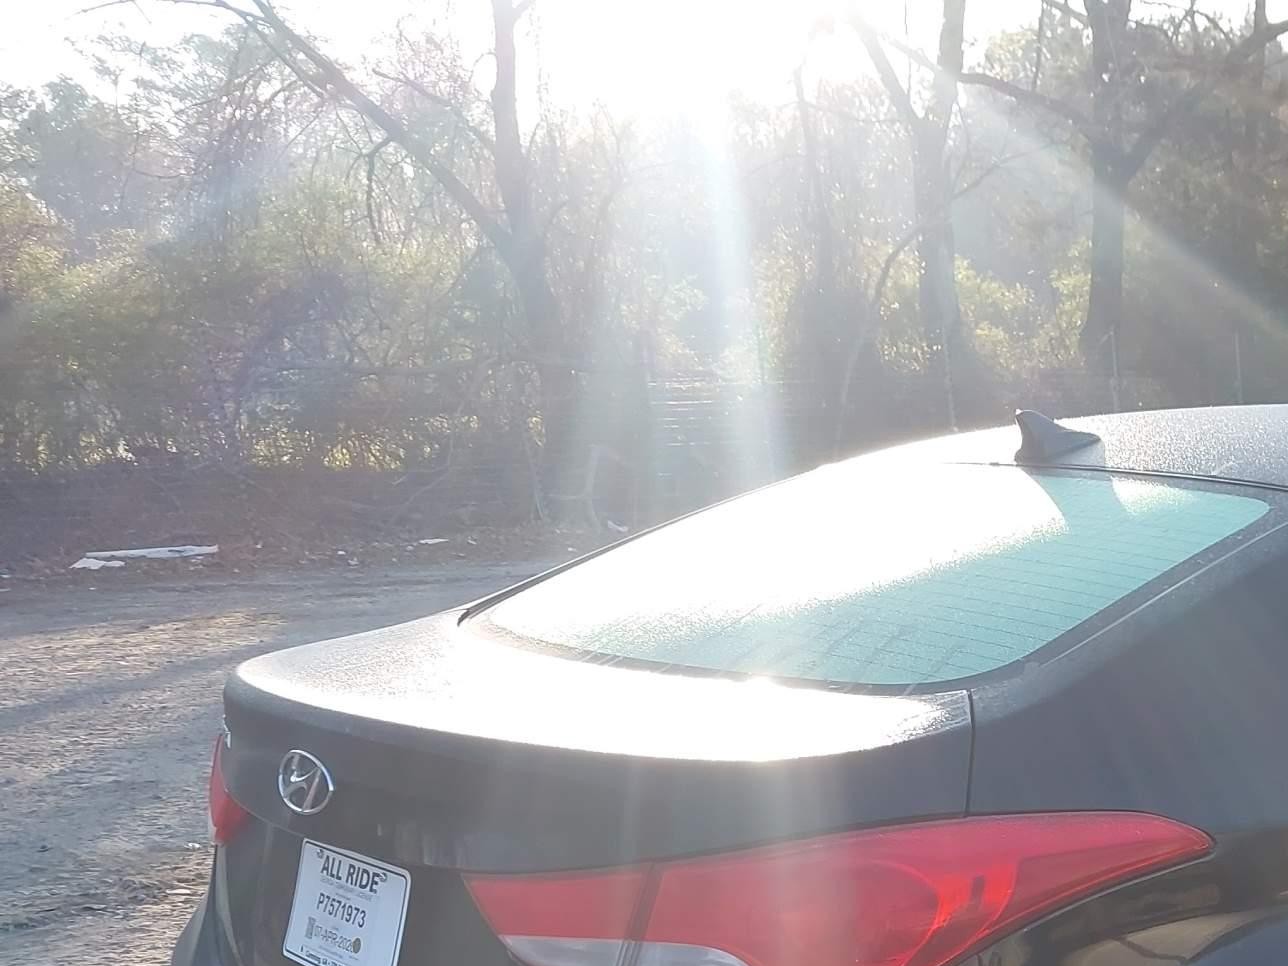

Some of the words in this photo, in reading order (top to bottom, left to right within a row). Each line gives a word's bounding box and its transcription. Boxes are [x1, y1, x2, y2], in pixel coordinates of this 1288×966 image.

[320, 855, 342, 880] ALL
[345, 863, 380, 893] RIDE
[316, 892, 366, 928] P7571973
